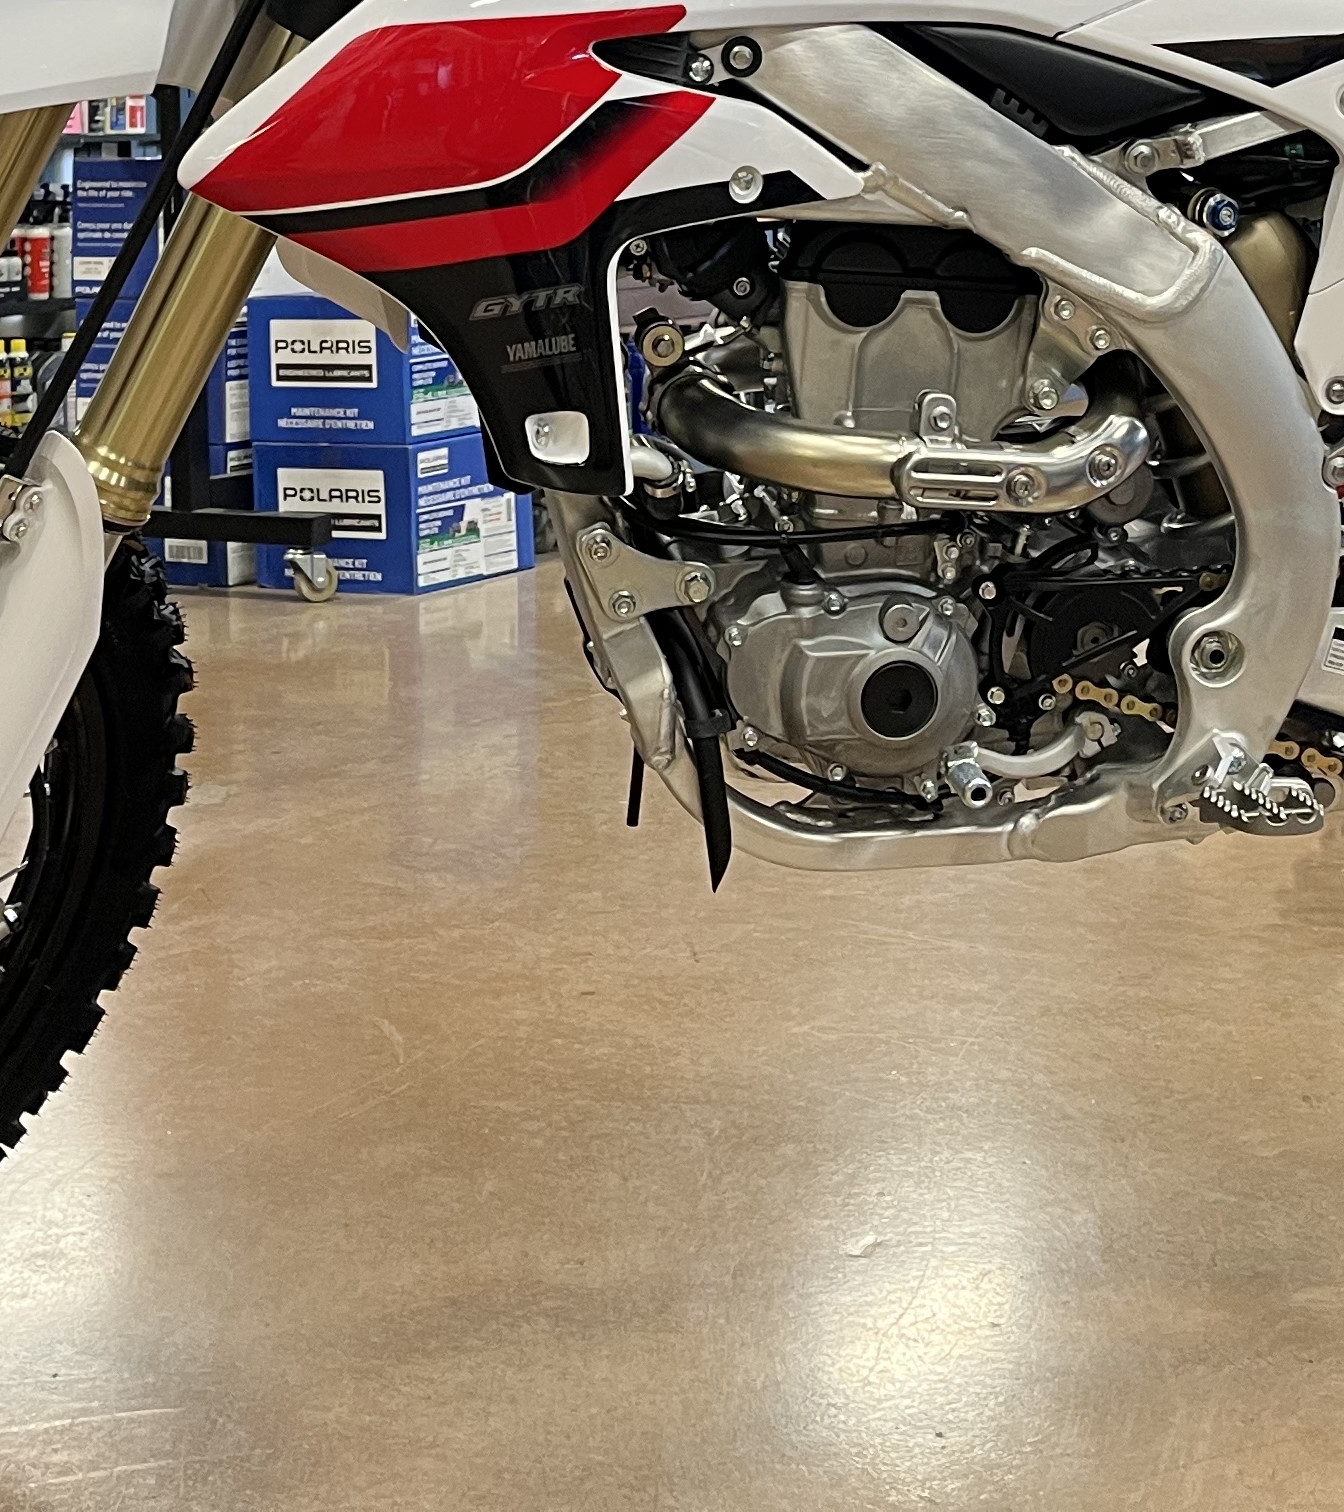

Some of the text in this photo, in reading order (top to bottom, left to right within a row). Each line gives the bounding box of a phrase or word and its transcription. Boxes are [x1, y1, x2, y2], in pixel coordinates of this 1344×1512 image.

[469, 283, 584, 321] GYTR
[274, 339, 373, 355] POLARIS
[506, 334, 576, 362] YAMALUBE
[291, 407, 359, 417] MAINTENANCE KIT
[282, 486, 382, 504] POLARIS
[355, 559, 367, 568] KIT
